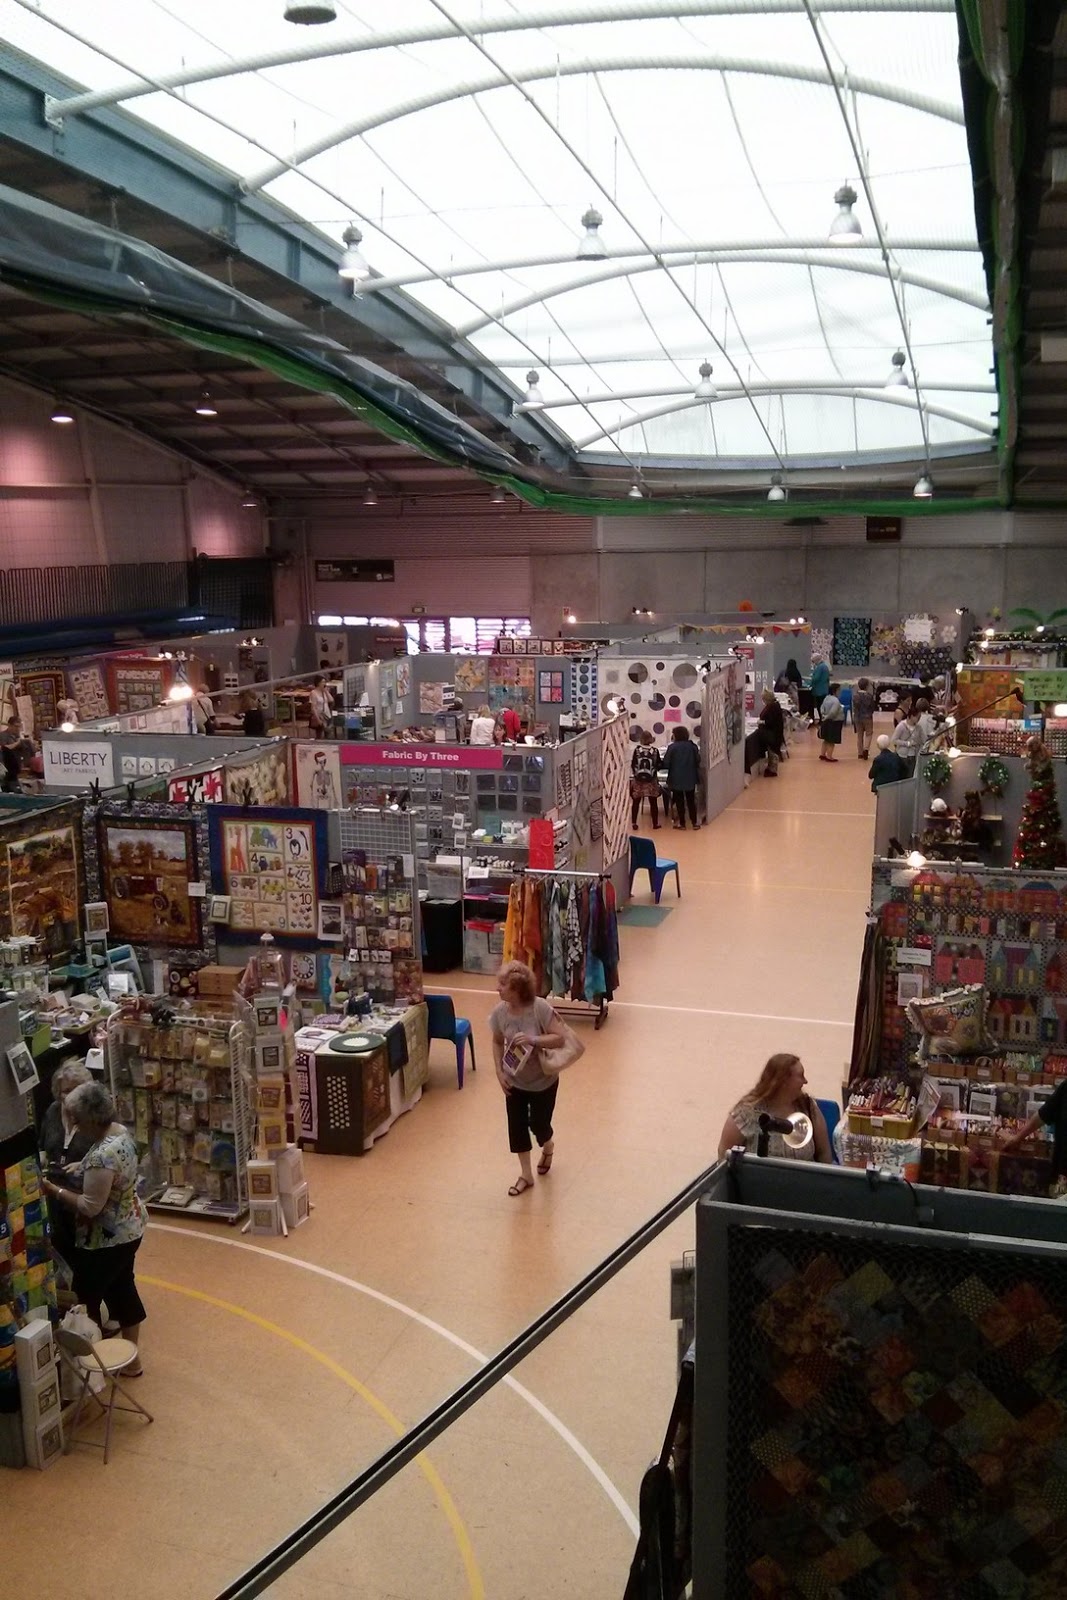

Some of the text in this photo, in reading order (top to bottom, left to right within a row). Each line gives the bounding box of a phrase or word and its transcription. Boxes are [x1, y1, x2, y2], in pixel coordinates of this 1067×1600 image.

[50, 752, 107, 766] LIBERTY
[382, 751, 459, 762] Fabric By Three
[285, 827, 293, 839] 3
[251, 853, 258, 863] 4
[231, 877, 238, 888] 6
[299, 893, 312, 905] 10
[278, 916, 286, 928] 9
[1, 1223, 6, 1233] 5
